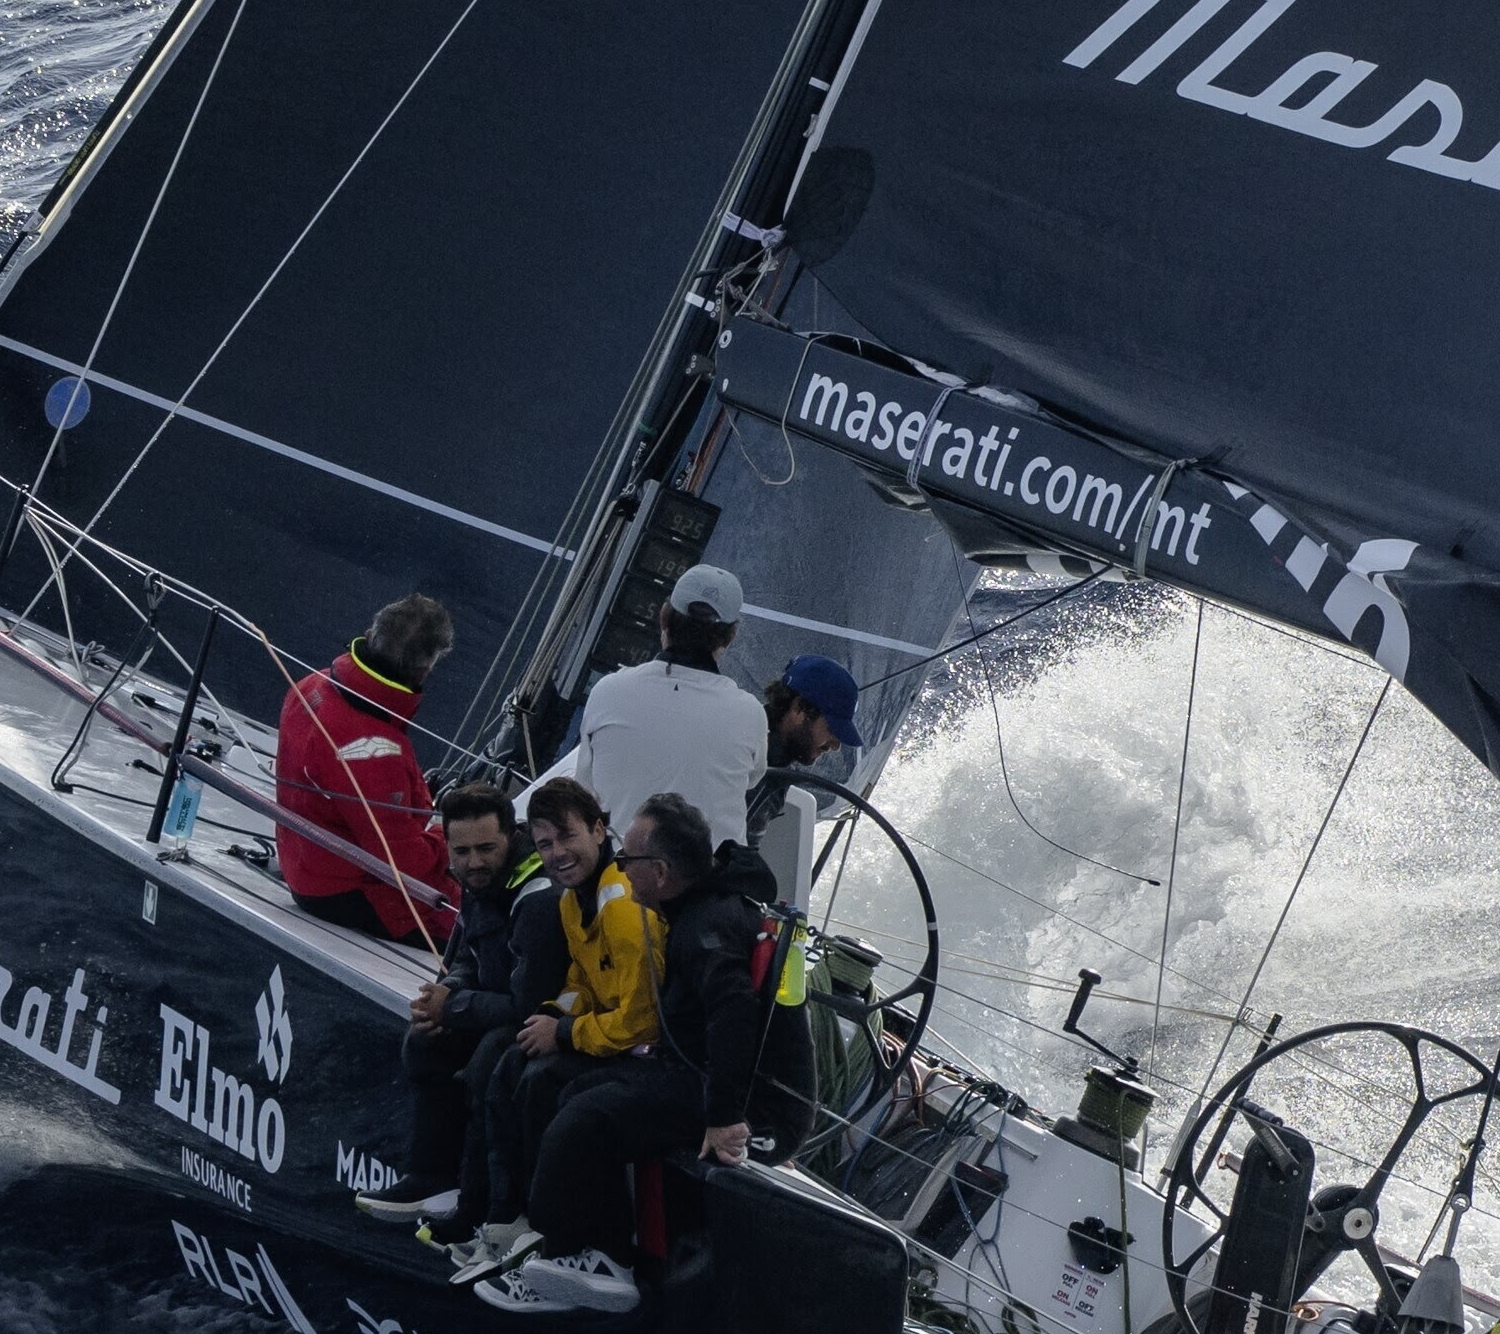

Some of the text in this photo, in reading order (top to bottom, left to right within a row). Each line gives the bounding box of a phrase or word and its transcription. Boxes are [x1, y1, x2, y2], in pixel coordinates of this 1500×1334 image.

[800, 372, 1211, 566] maserati.com/mt
[154, 1002, 285, 1174] Elmo
[182, 1146, 252, 1212] INSURANCE
[171, 1219, 274, 1315] RLR
